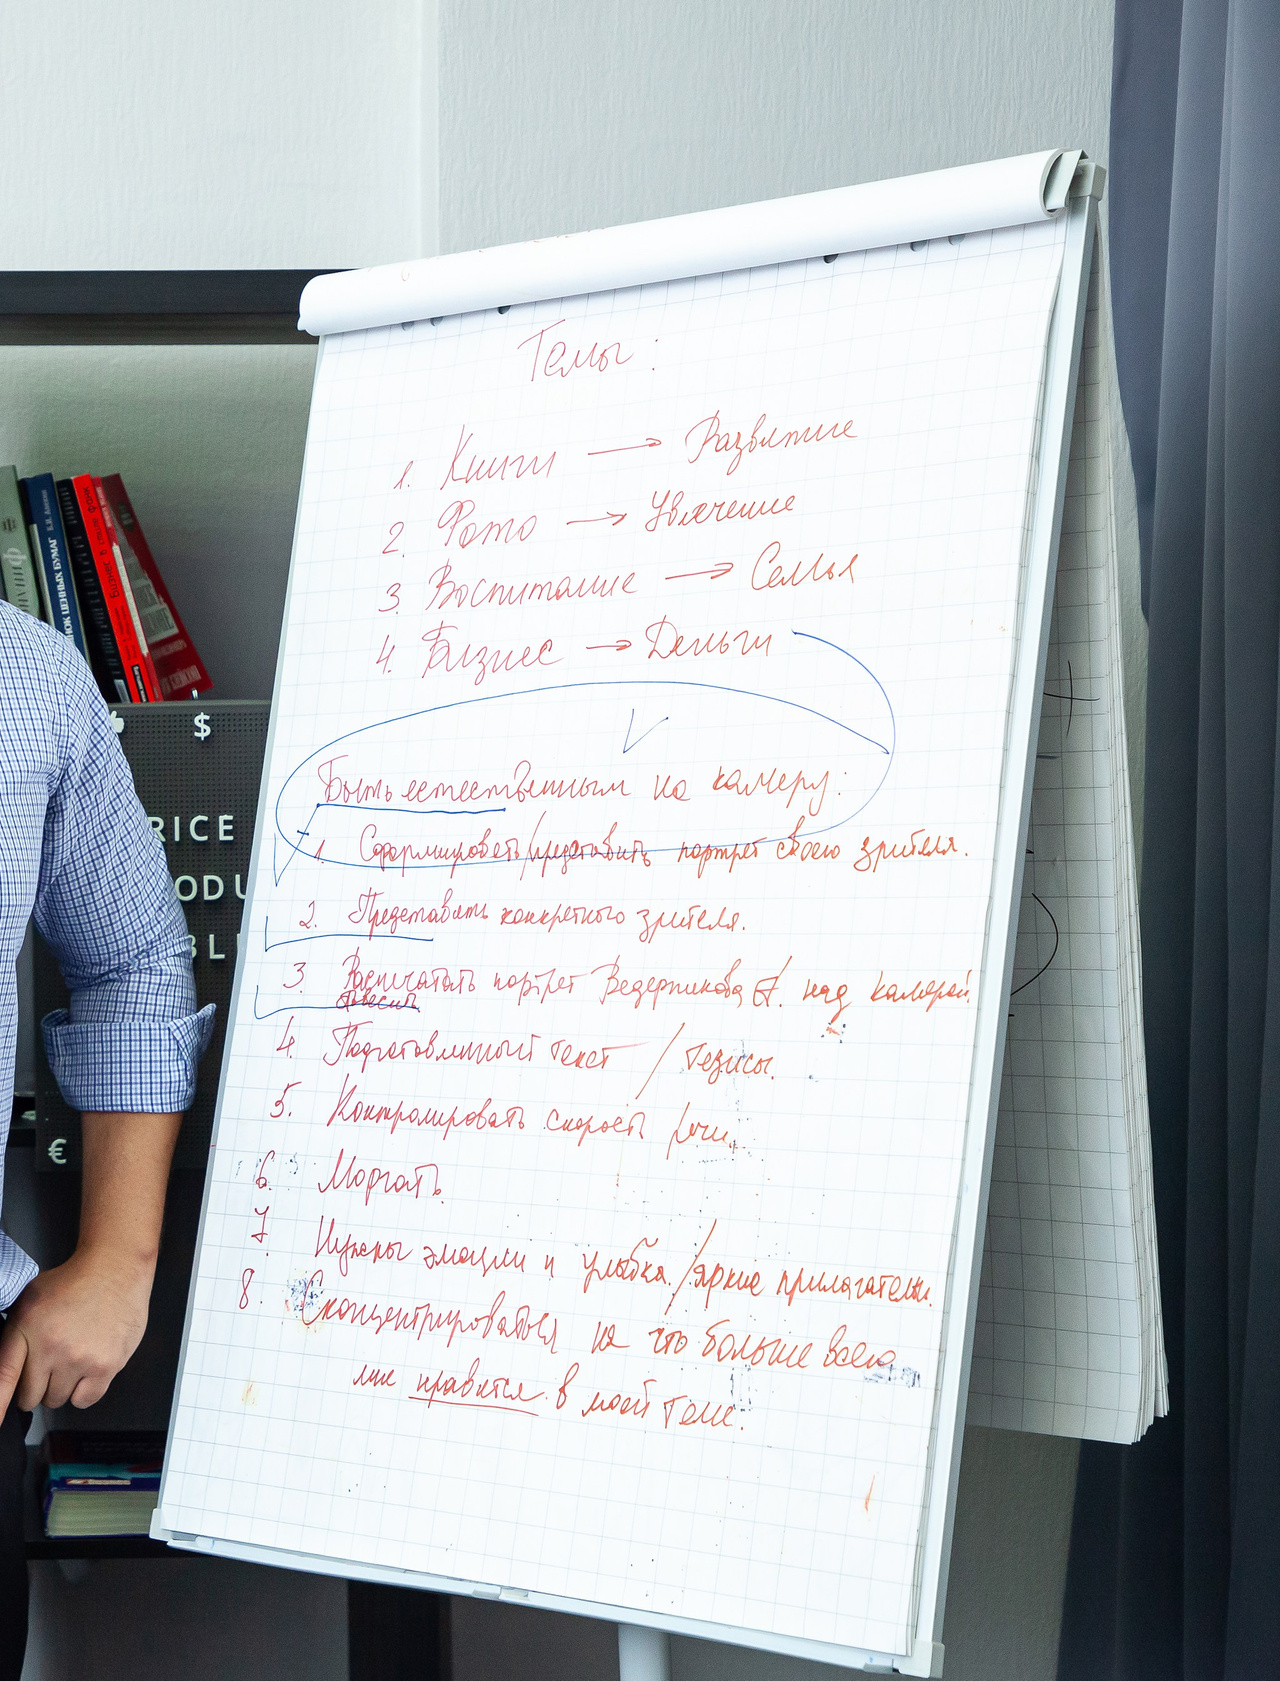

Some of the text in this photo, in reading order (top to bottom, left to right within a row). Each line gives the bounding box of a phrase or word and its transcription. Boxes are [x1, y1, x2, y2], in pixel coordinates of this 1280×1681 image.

[440, 424, 557, 491] Книги
[685, 409, 859, 476] Развитие
[80, 485, 98, 515] фанк
[382, 522, 406, 558] 2.
[437, 500, 538, 550] Фото
[47, 537, 62, 571] БУМАГ
[53, 570, 70, 616] ЦЕННЫХ
[102, 559, 120, 599] Бизнес
[378, 541, 859, 615] 3. Воспитание Семья
[376, 615, 772, 686] 4. Бизнес Деньги
[317, 754, 394, 804] Быть
[401, 760, 632, 804] естественным
[654, 775, 691, 801] на
[678, 837, 768, 879] портрет
[348, 887, 489, 941] Представить
[500, 903, 626, 933] конкретного
[283, 961, 306, 994] 3.
[493, 968, 588, 1006] портрет
[551, 1041, 650, 1069] текст
[270, 1081, 302, 1118] 5.
[423, 1243, 525, 1278] эмоции
[592, 1321, 631, 1355] на
[649, 1327, 688, 1355] что
[702, 1319, 809, 1368] больше
[582, 1379, 657, 1418] моей
